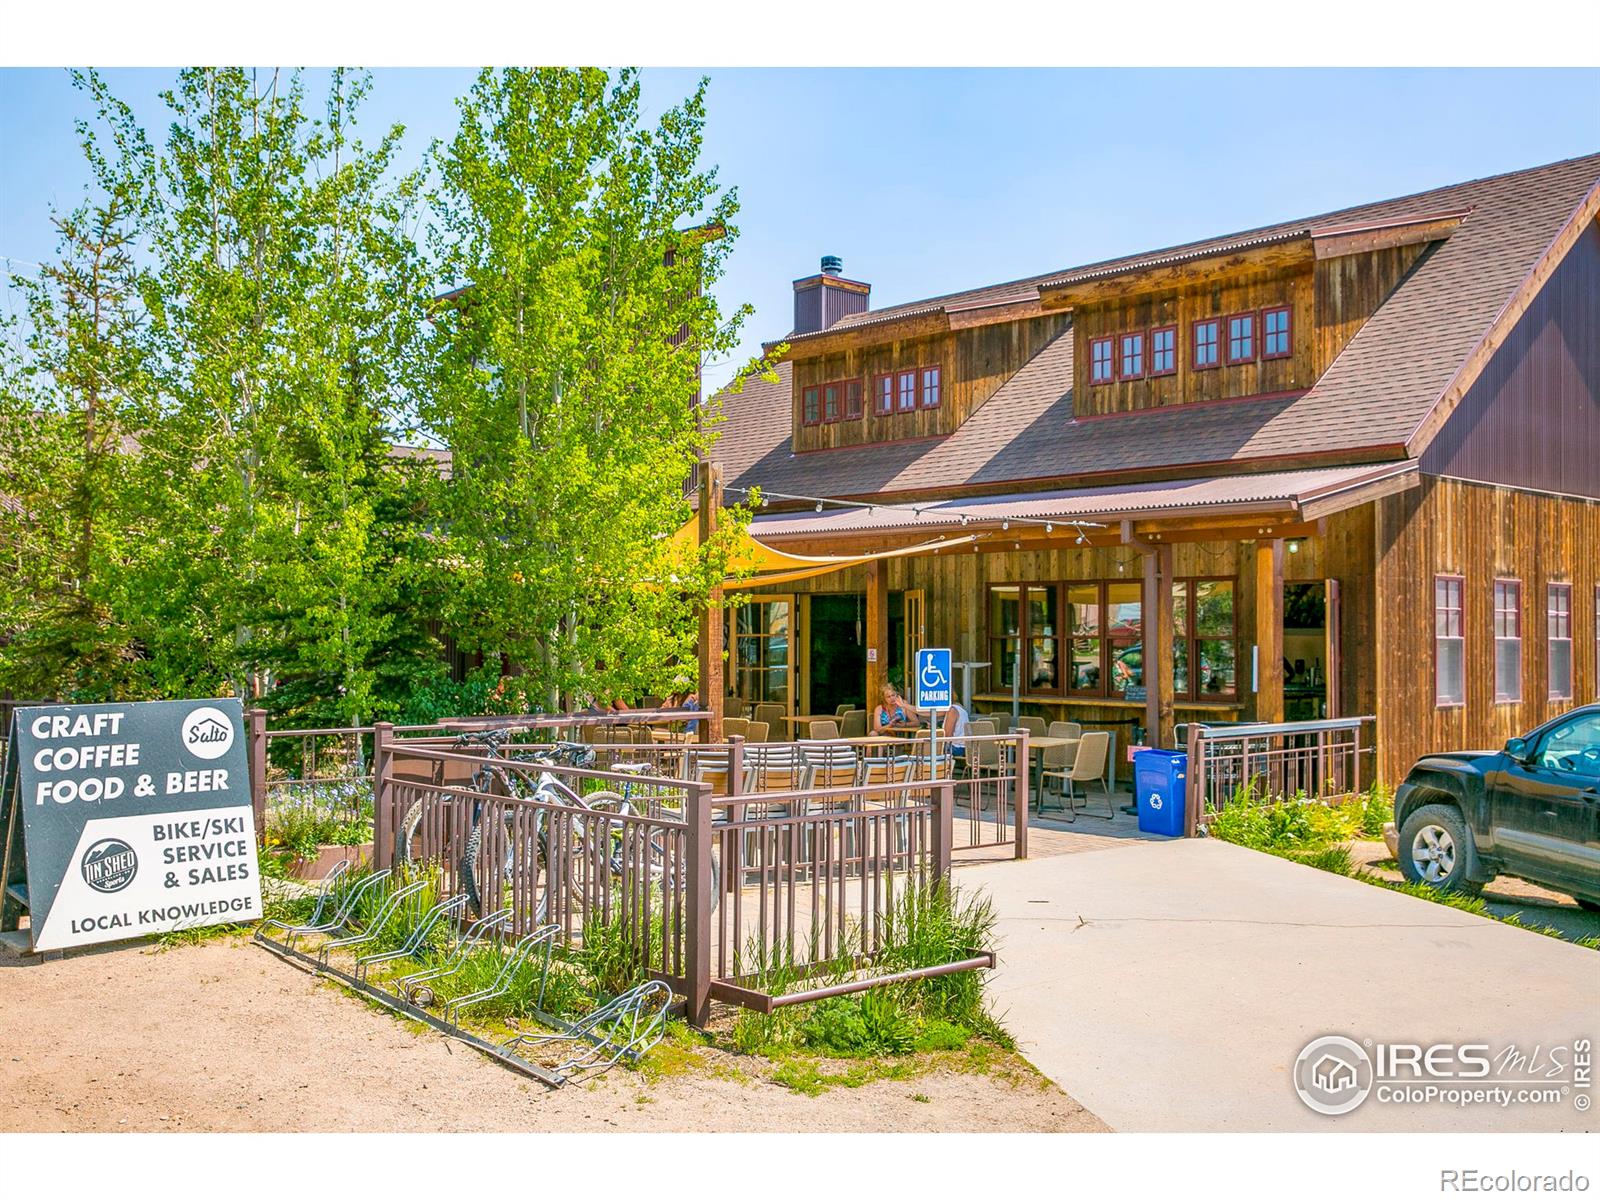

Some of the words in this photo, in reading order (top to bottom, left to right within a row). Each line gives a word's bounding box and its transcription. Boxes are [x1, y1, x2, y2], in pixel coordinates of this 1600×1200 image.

[920, 689, 948, 702] PARKING
[31, 712, 125, 739] CRAFT
[188, 724, 228, 744] Salto
[33, 743, 140, 772] COFFEE
[35, 776, 125, 805] FOOD
[133, 774, 157, 797] &
[166, 769, 229, 794] BEER
[153, 817, 244, 841] BIKE/SKI
[163, 840, 247, 864] SERVICE
[84, 862, 102, 885] TIN
[104, 851, 135, 877] SHED
[163, 872, 180, 888] &
[188, 863, 249, 885] SALES
[71, 913, 132, 934] LOCAL
[138, 897, 252, 923] KNOWLEDGE
